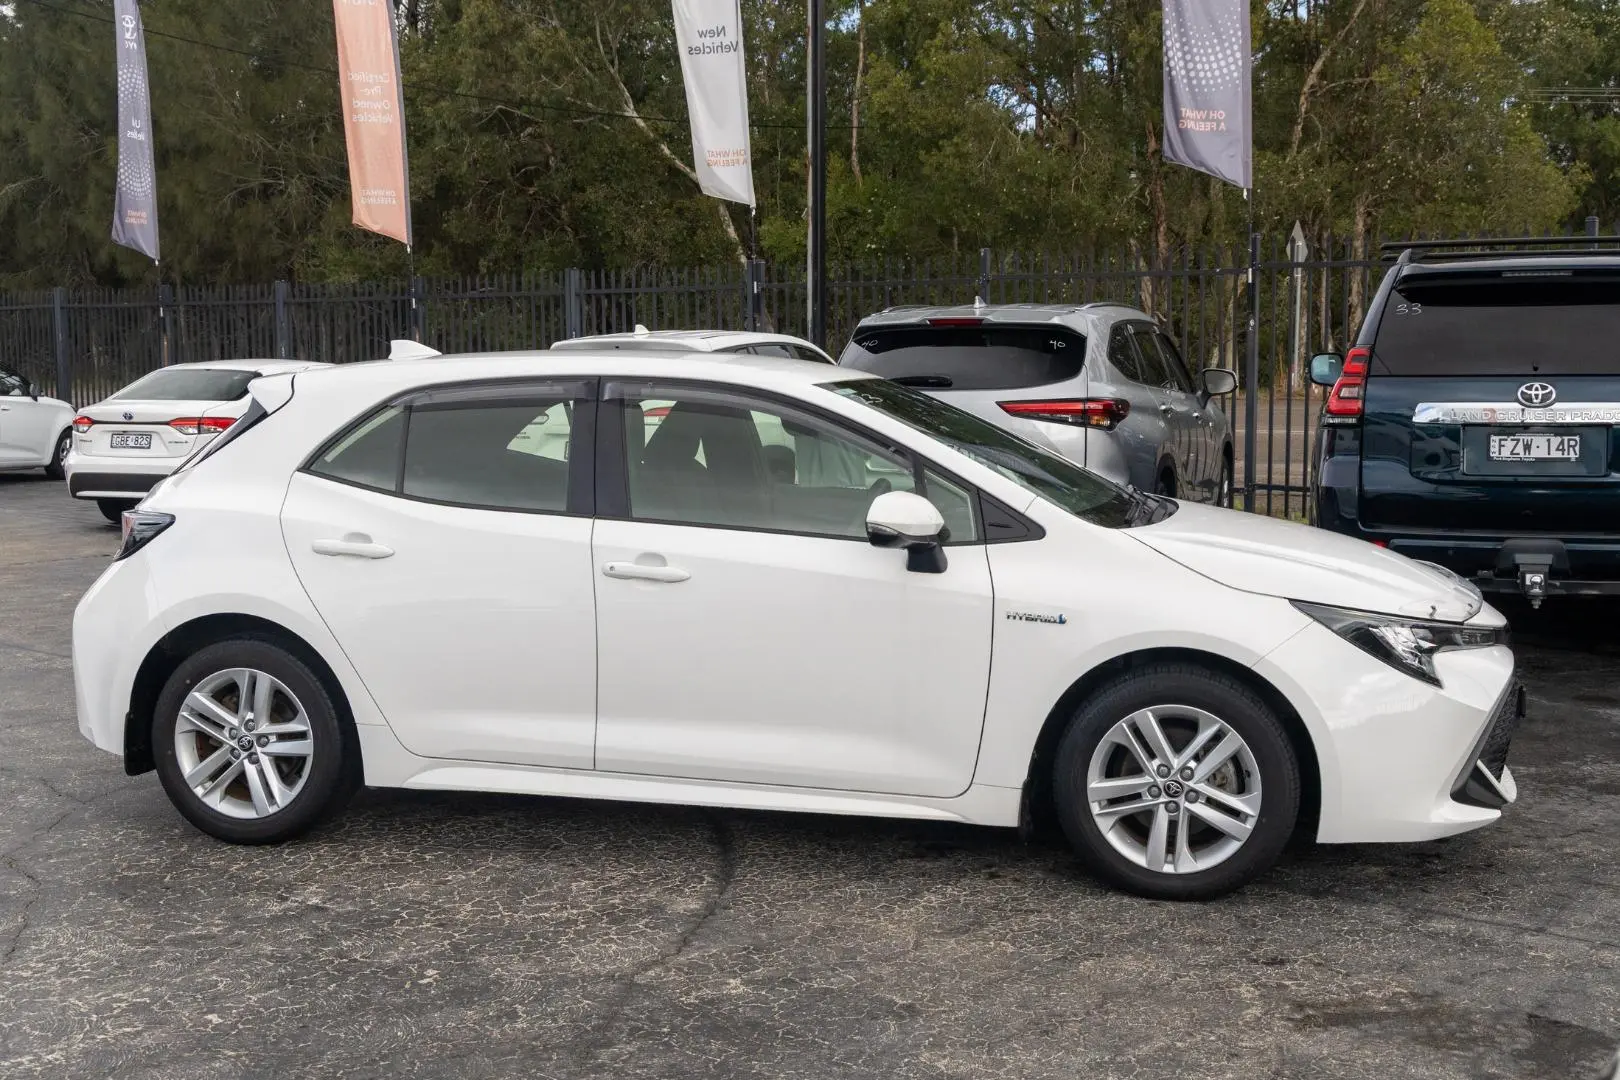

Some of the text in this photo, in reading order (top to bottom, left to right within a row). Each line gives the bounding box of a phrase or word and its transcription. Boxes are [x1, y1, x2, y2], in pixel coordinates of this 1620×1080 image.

[1396, 302, 1421, 316] 33
[862, 339, 879, 350] 40
[1049, 340, 1066, 350] 40
[1451, 411, 1491, 421] LAND
[1496, 411, 1566, 421] CRUISER
[115, 435, 150, 447] GBE 82S
[1006, 611, 1058, 624] HYBRID
